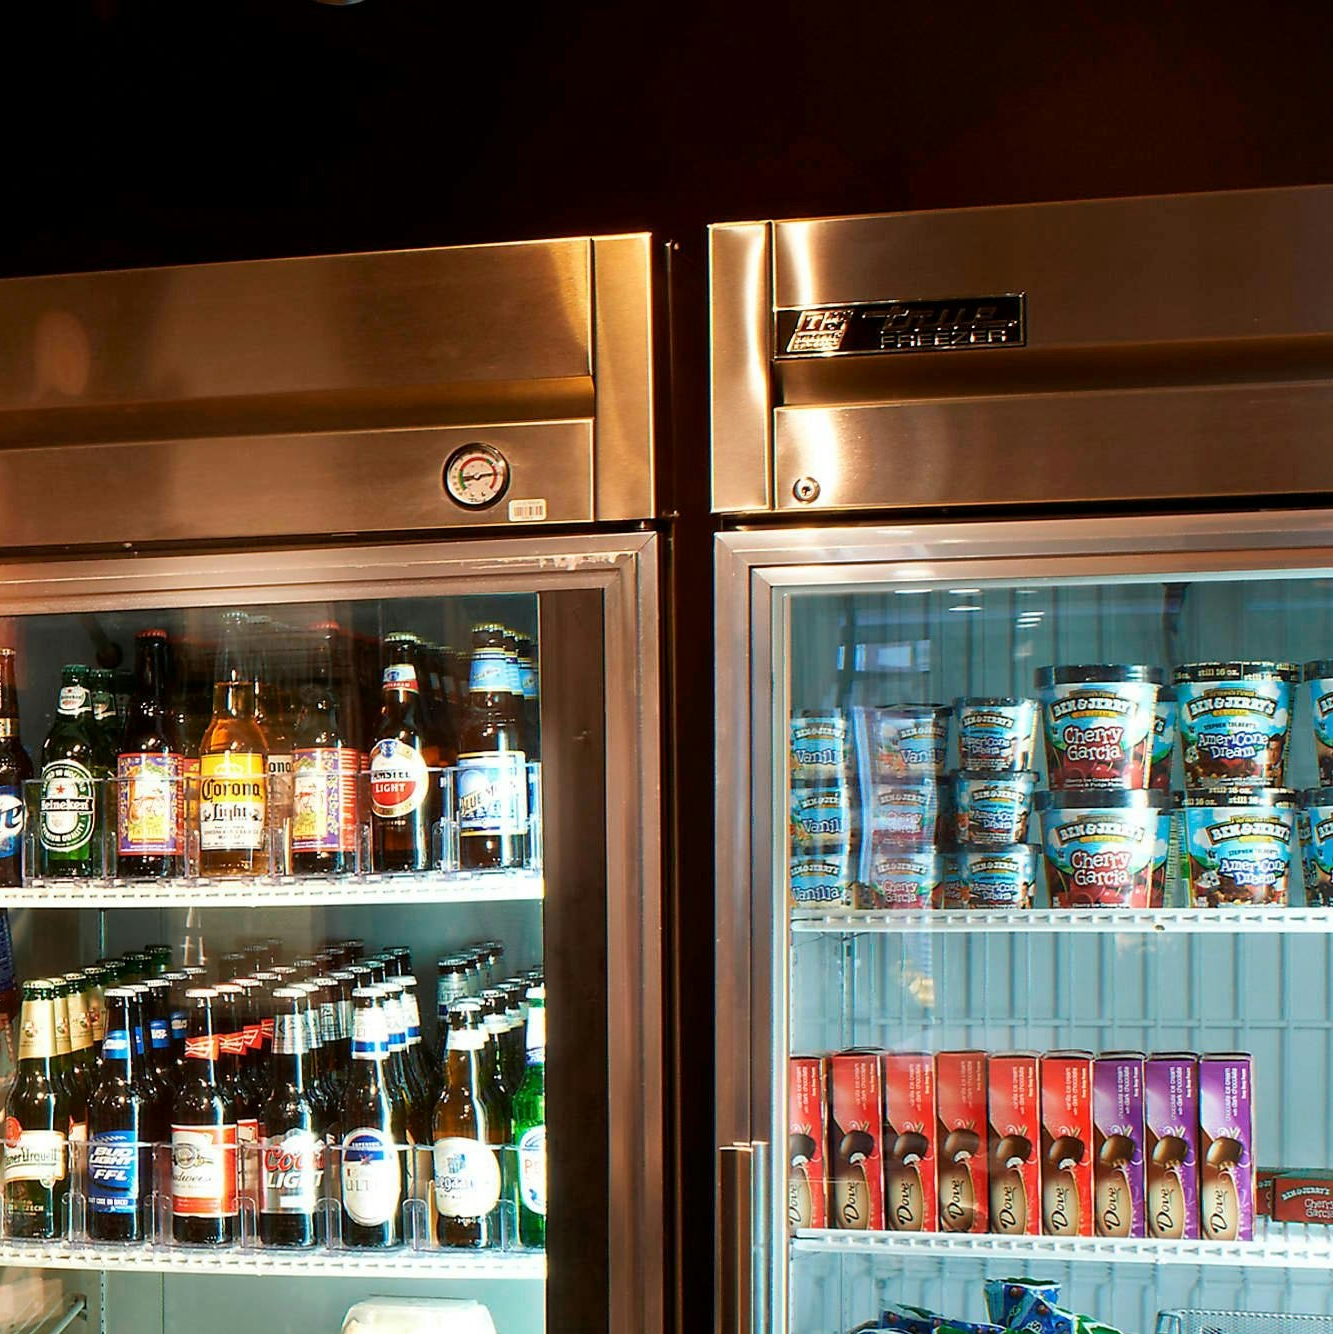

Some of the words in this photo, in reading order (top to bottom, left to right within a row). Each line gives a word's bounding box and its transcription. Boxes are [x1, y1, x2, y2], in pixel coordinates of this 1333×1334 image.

[879, 331, 1007, 349] FREEZER
[1053, 702, 1078, 719] BEN
[1189, 700, 1213, 717] BEN
[1063, 725, 1123, 745] Cherry
[1197, 732, 1269, 748] AmeriCone
[1066, 743, 1121, 761] Garcia
[1211, 744, 1256, 759] Dream
[201, 777, 262, 799] Corona
[375, 782, 406, 793] LIGHT
[212, 802, 248, 823] Light
[1070, 850, 1131, 870] Cherry
[1074, 867, 1129, 887] Garcia
[94, 1169, 129, 1181] FFL
[843, 1181, 860, 1225] Dove
[896, 1181, 913, 1225] Dove
[947, 1178, 965, 1220] Dove
[998, 1185, 1017, 1229] Dove
[1051, 1186, 1070, 1231] Dove
[1102, 1187, 1121, 1231] Dove
[1155, 1187, 1174, 1232] Dove
[1210, 1189, 1229, 1234] Dove
